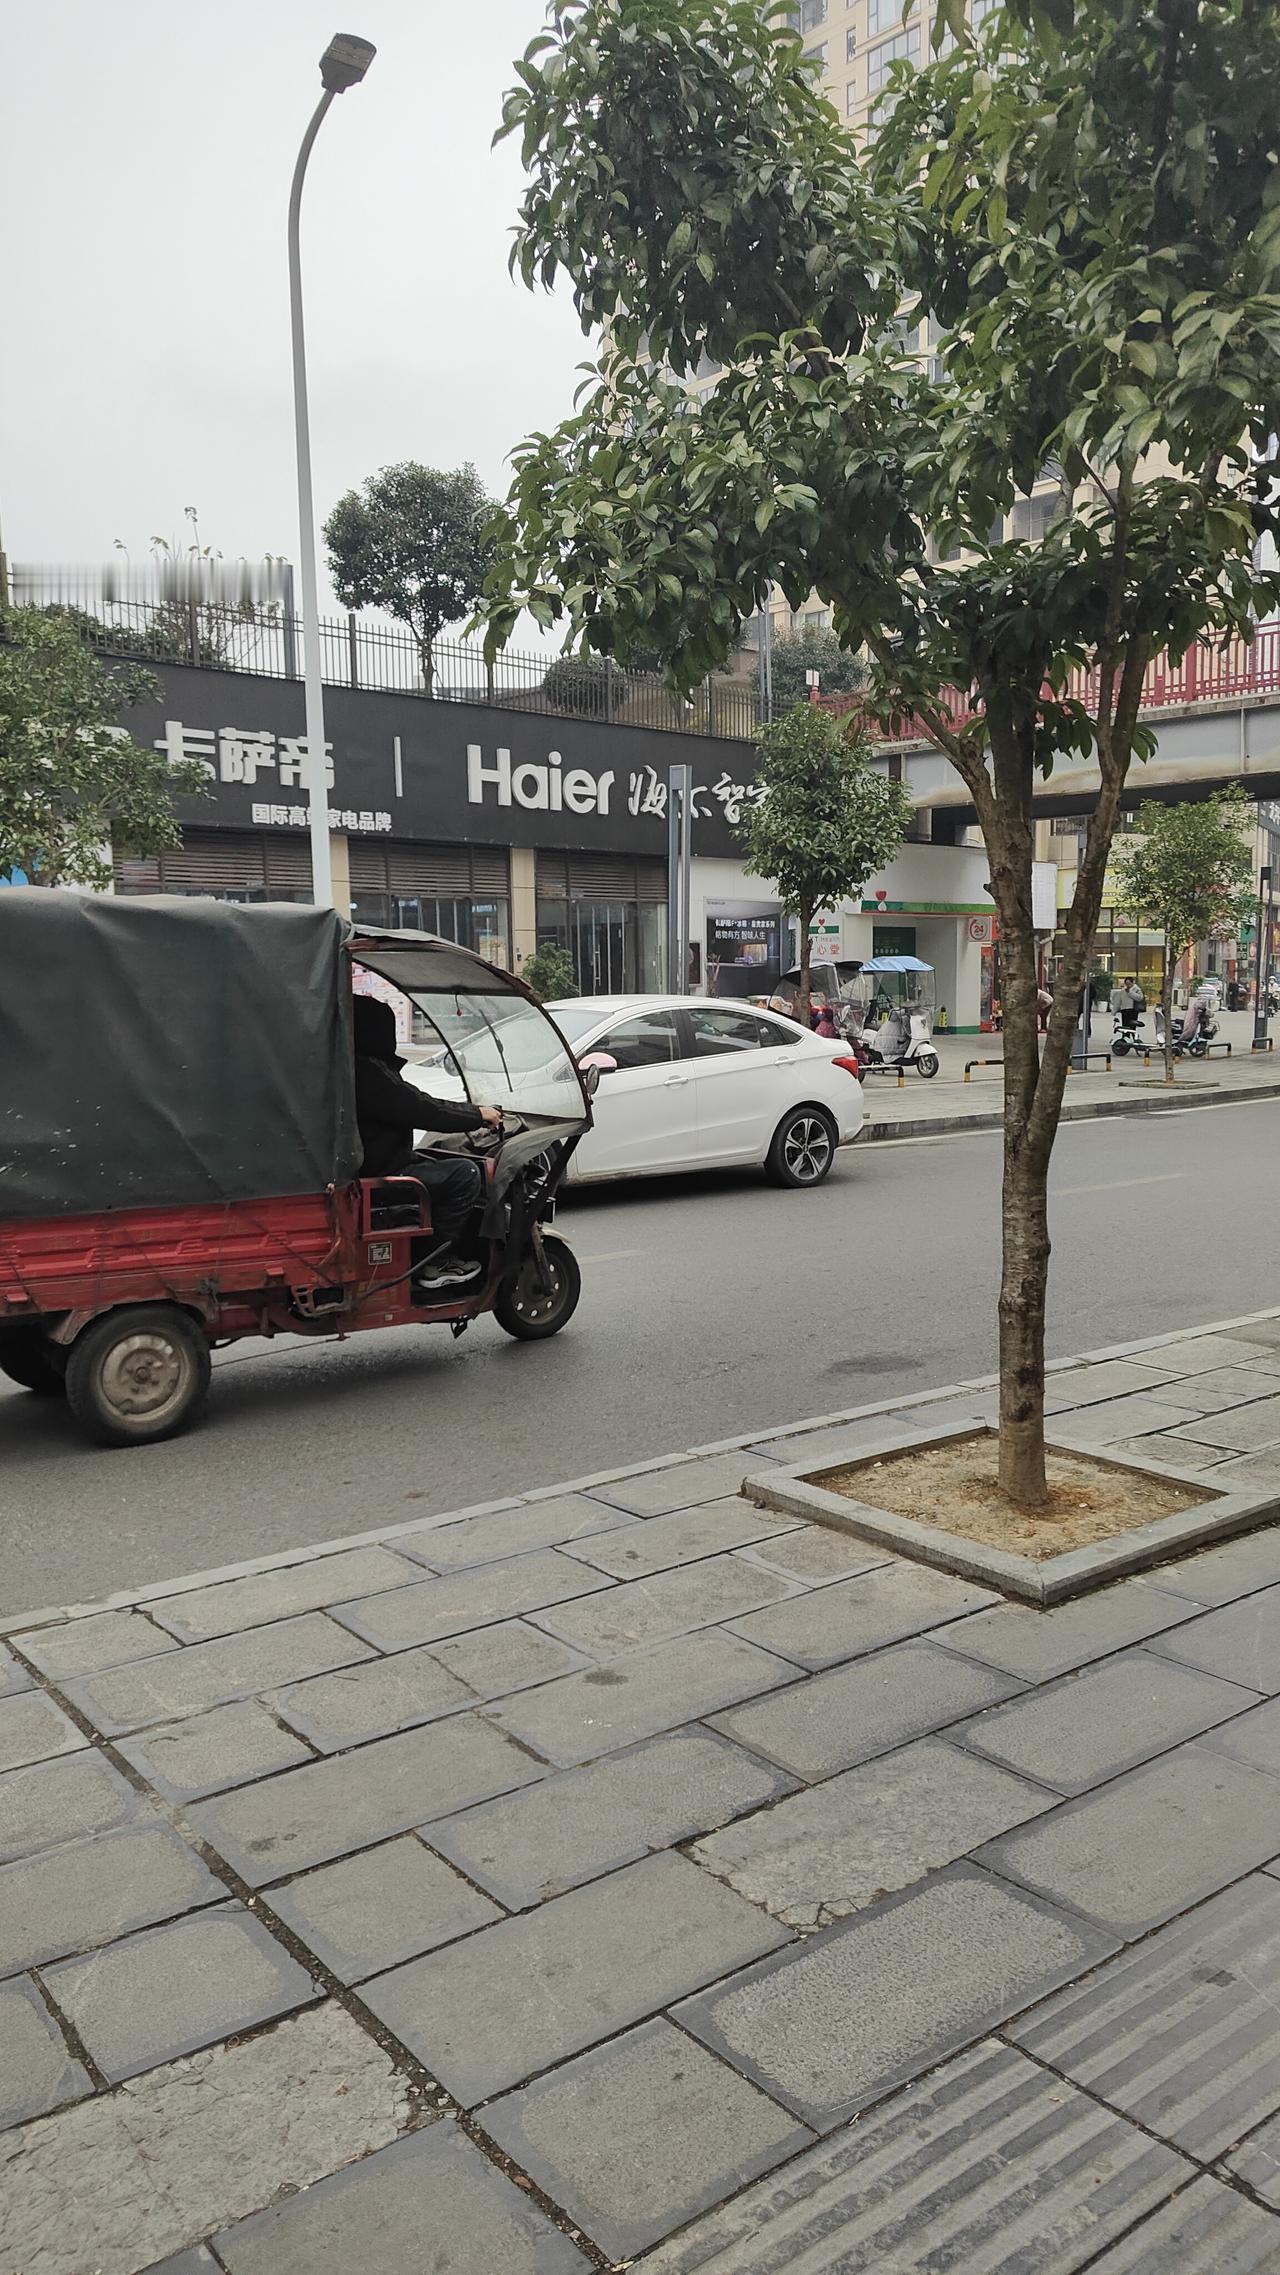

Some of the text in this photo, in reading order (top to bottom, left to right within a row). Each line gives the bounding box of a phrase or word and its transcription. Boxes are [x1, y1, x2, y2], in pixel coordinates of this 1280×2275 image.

[466, 743, 615, 815] Haier
[251, 803, 392, 832] 国际高家电品牌
